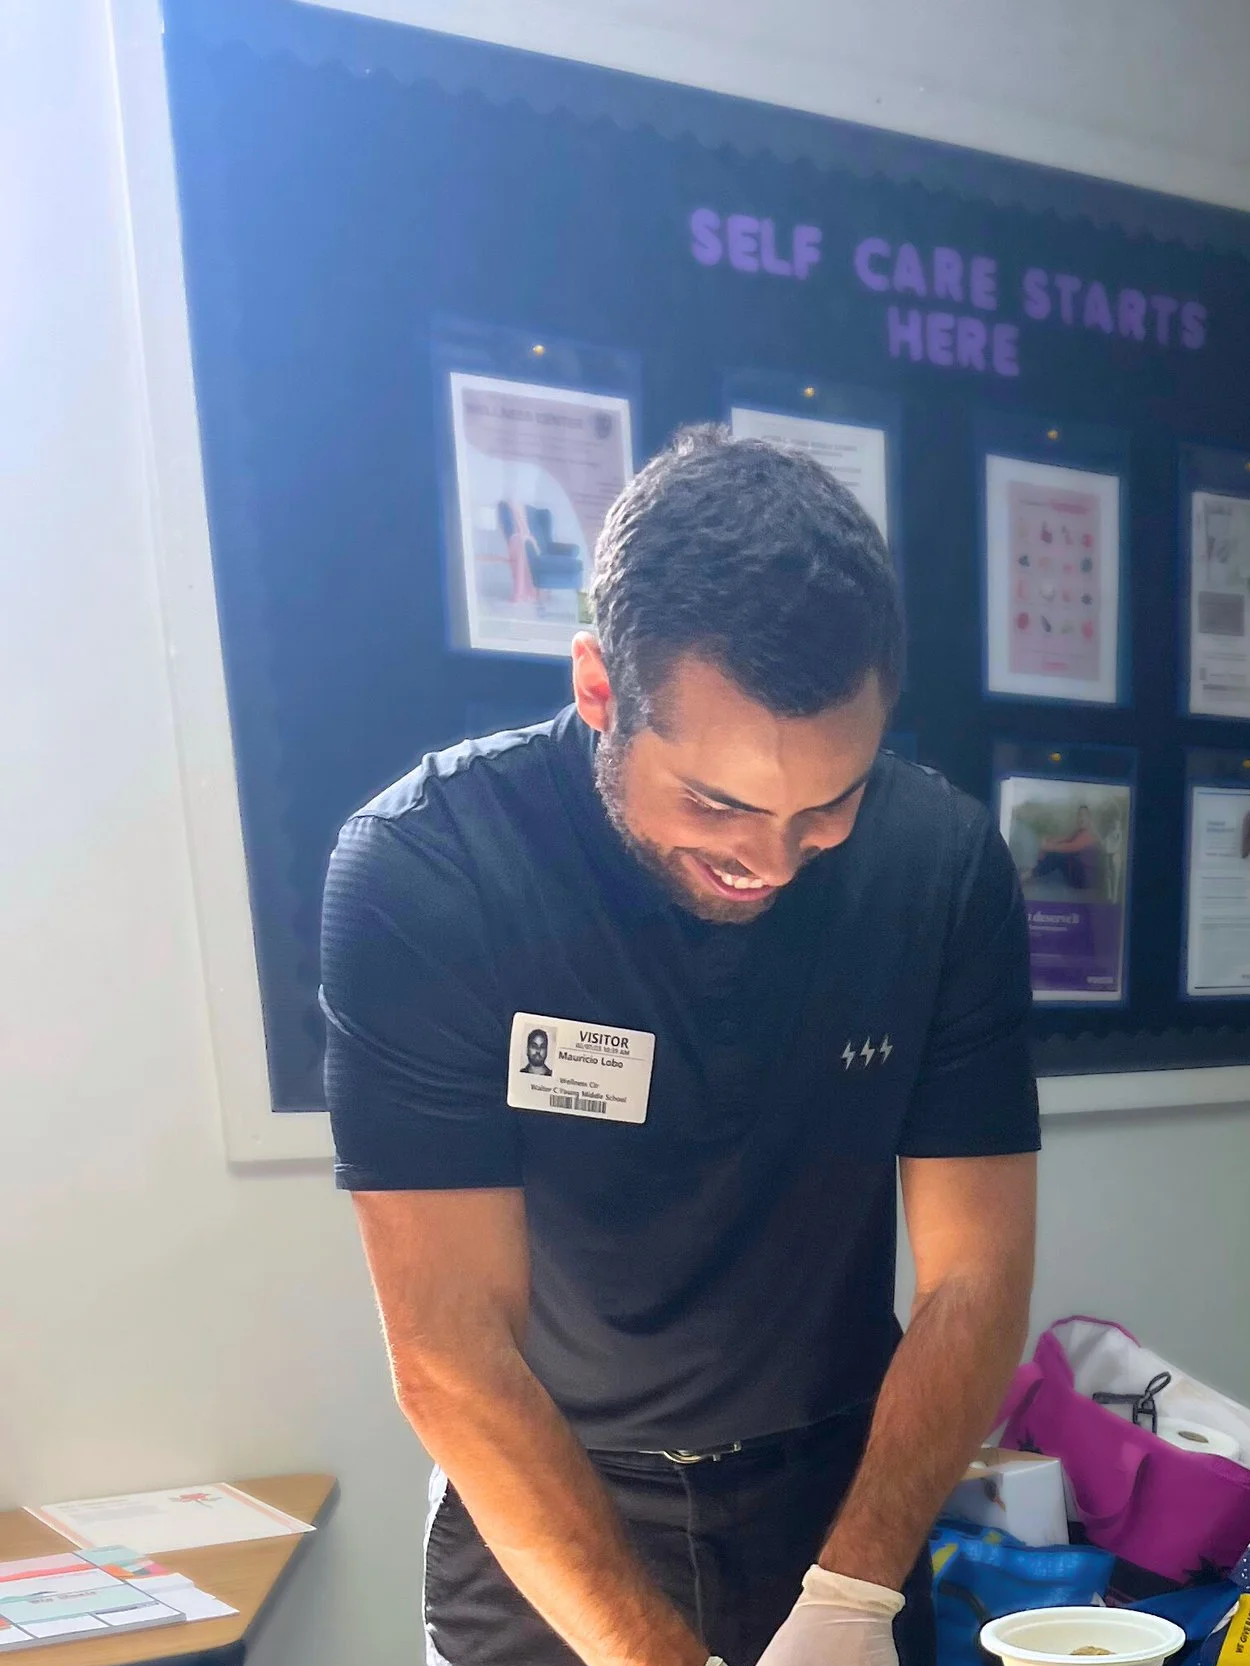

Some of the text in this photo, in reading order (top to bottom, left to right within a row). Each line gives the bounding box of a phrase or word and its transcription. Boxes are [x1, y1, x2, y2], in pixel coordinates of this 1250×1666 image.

[690, 208, 1208, 350] SELF CARE STARTS
[888, 305, 1021, 378] HERE
[579, 1030, 629, 1049] VISITOR
[558, 1051, 599, 1065] Mauricio
[605, 1094, 627, 1103] School
